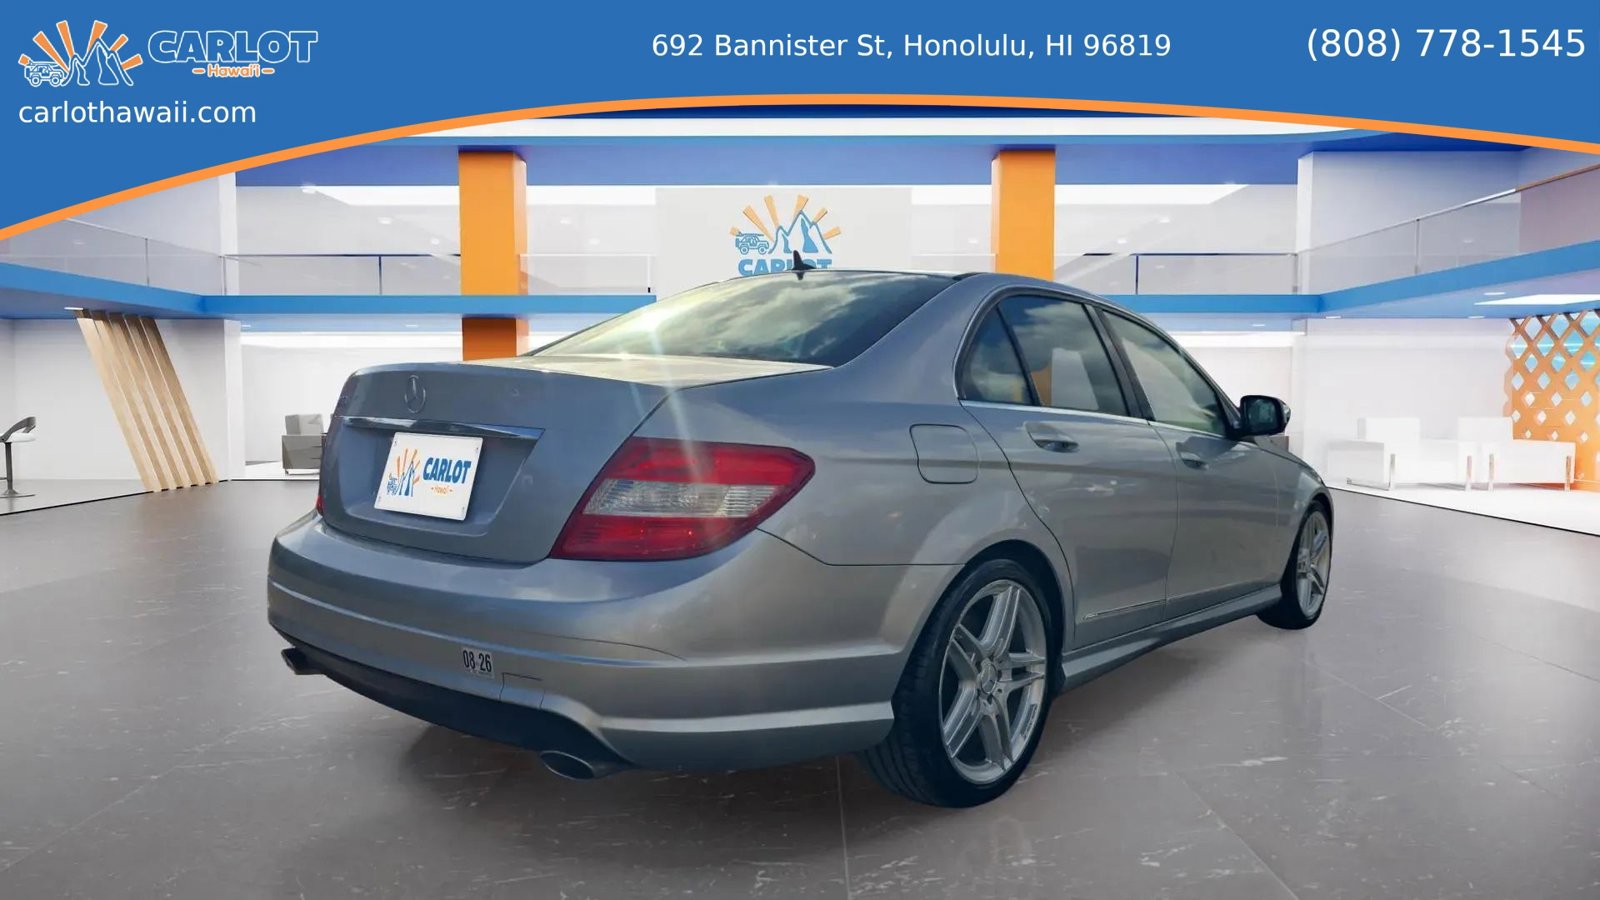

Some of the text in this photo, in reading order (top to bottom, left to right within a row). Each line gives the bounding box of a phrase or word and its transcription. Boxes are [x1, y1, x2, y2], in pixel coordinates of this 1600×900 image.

[422, 457, 472, 484] CARLOT
[463, 650, 492, 672] 08 26
